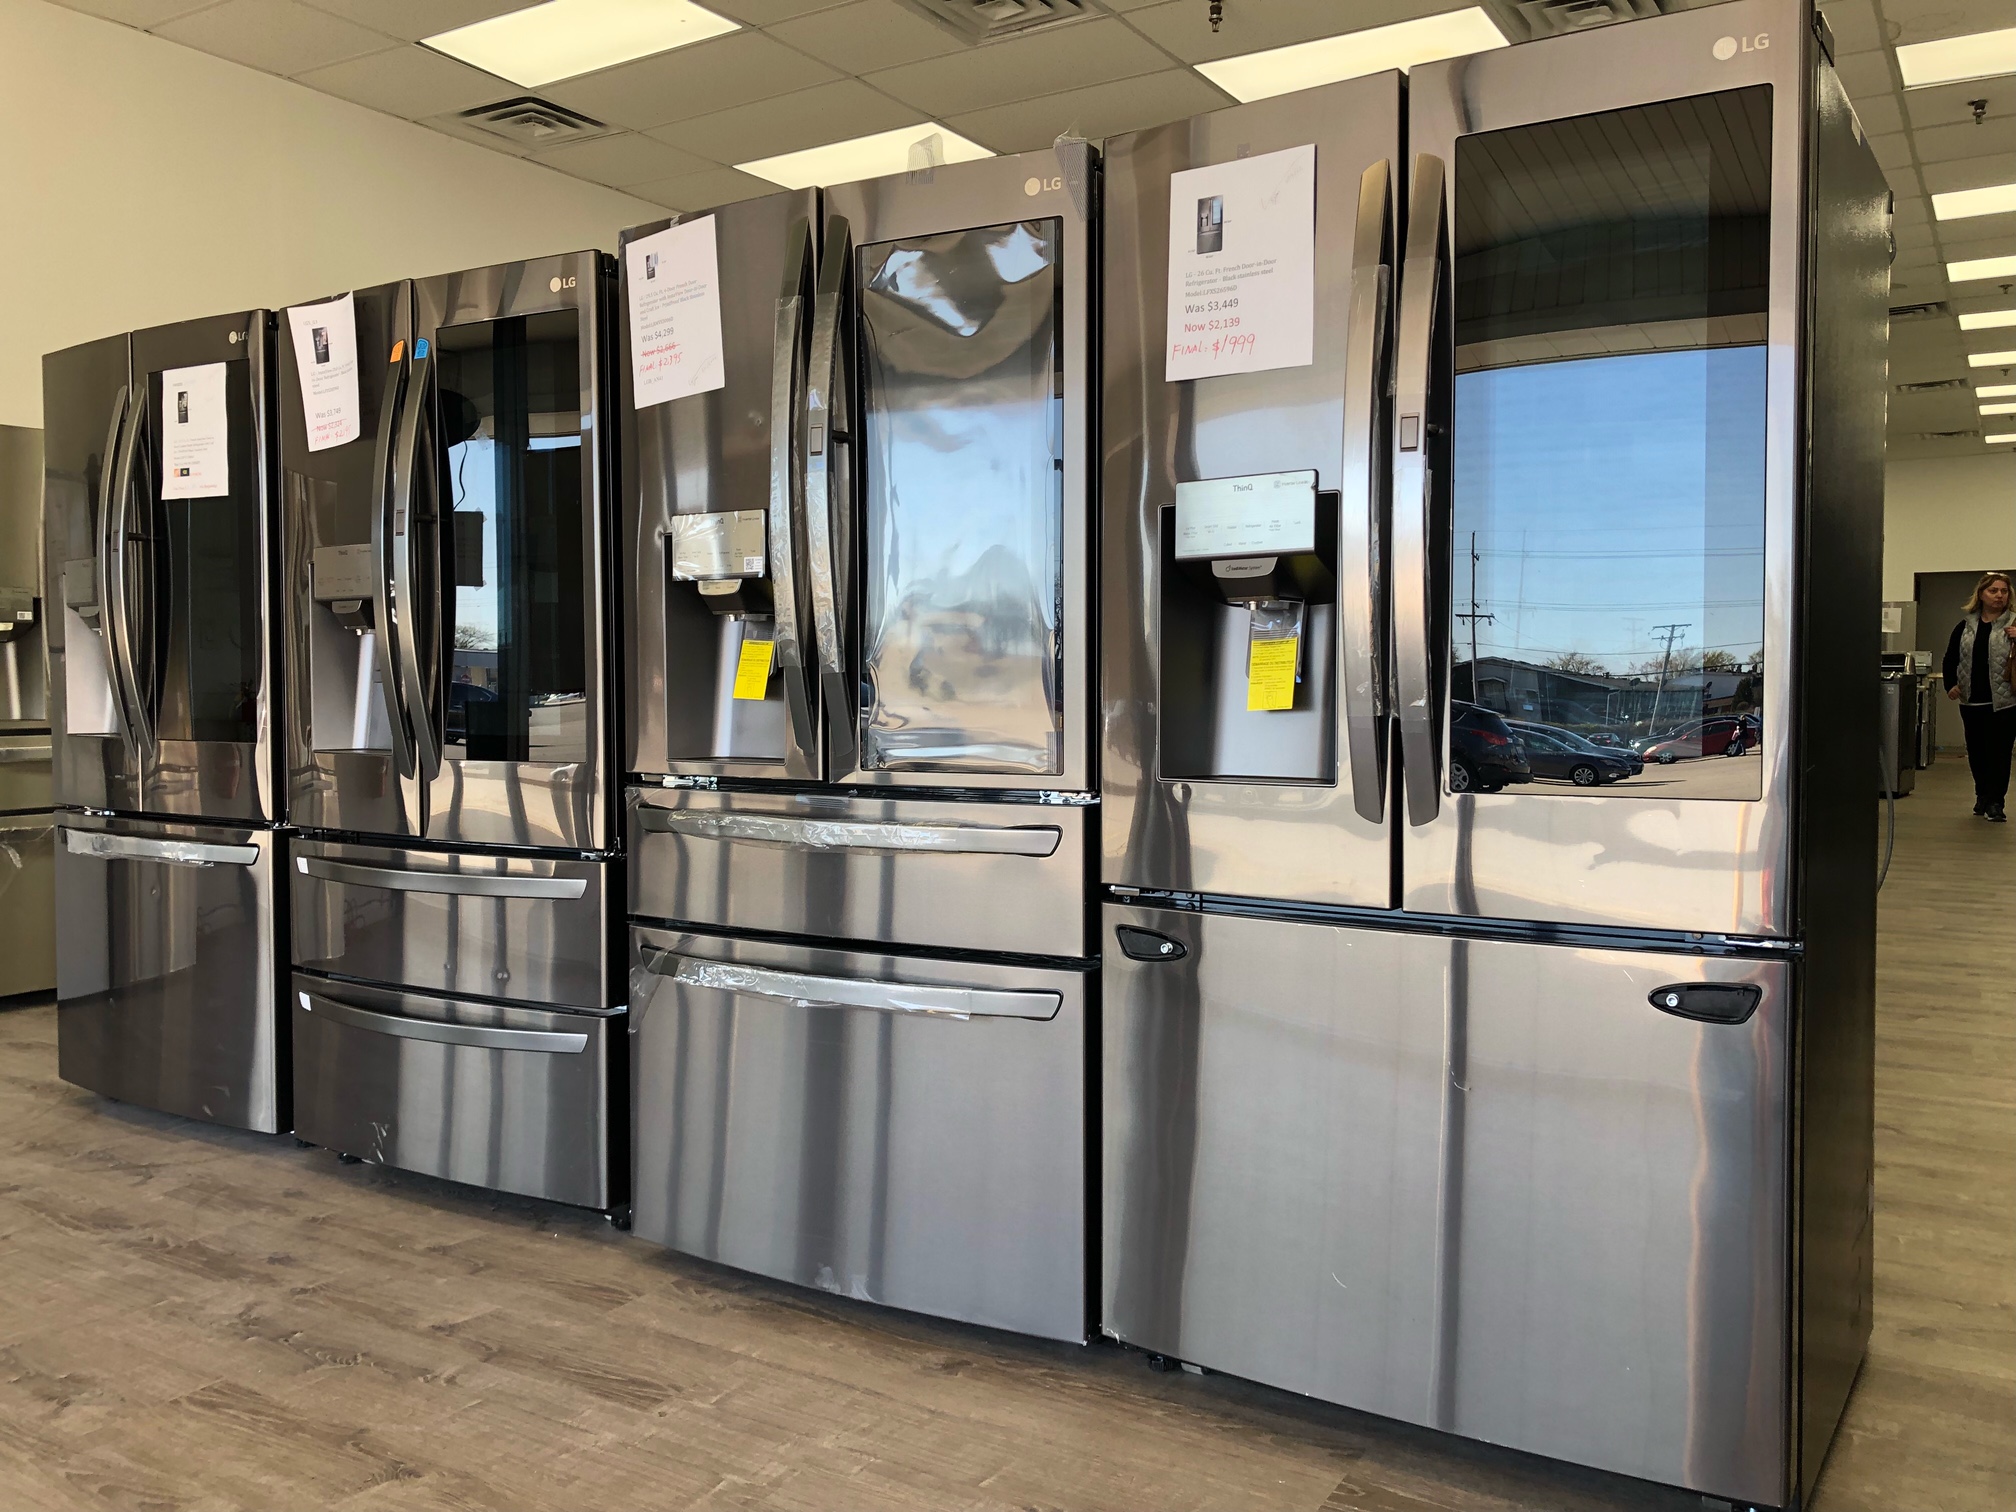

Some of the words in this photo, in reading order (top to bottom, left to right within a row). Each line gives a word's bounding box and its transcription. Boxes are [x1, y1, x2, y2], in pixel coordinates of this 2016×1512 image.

[1742, 33, 1769, 52] LG
[1043, 177, 1061, 191] LG
[1223, 264, 1241, 273] French
[562, 277, 576, 288] LG
[1185, 277, 1218, 288] Refrigerator
[1222, 273, 1237, 282] Black
[1237, 270, 1260, 280] stainless
[1260, 267, 1274, 276] steel
[1185, 304, 1205, 314] Was
[1207, 298, 1239, 312] $3,449
[1184, 323, 1206, 333] Now
[1208, 317, 1240, 331] $2,139
[641, 334, 654, 343] Was
[654, 327, 674, 340] $4,299
[1212, 333, 1256, 360] $1999
[1233, 483, 1253, 492] ThinQ
